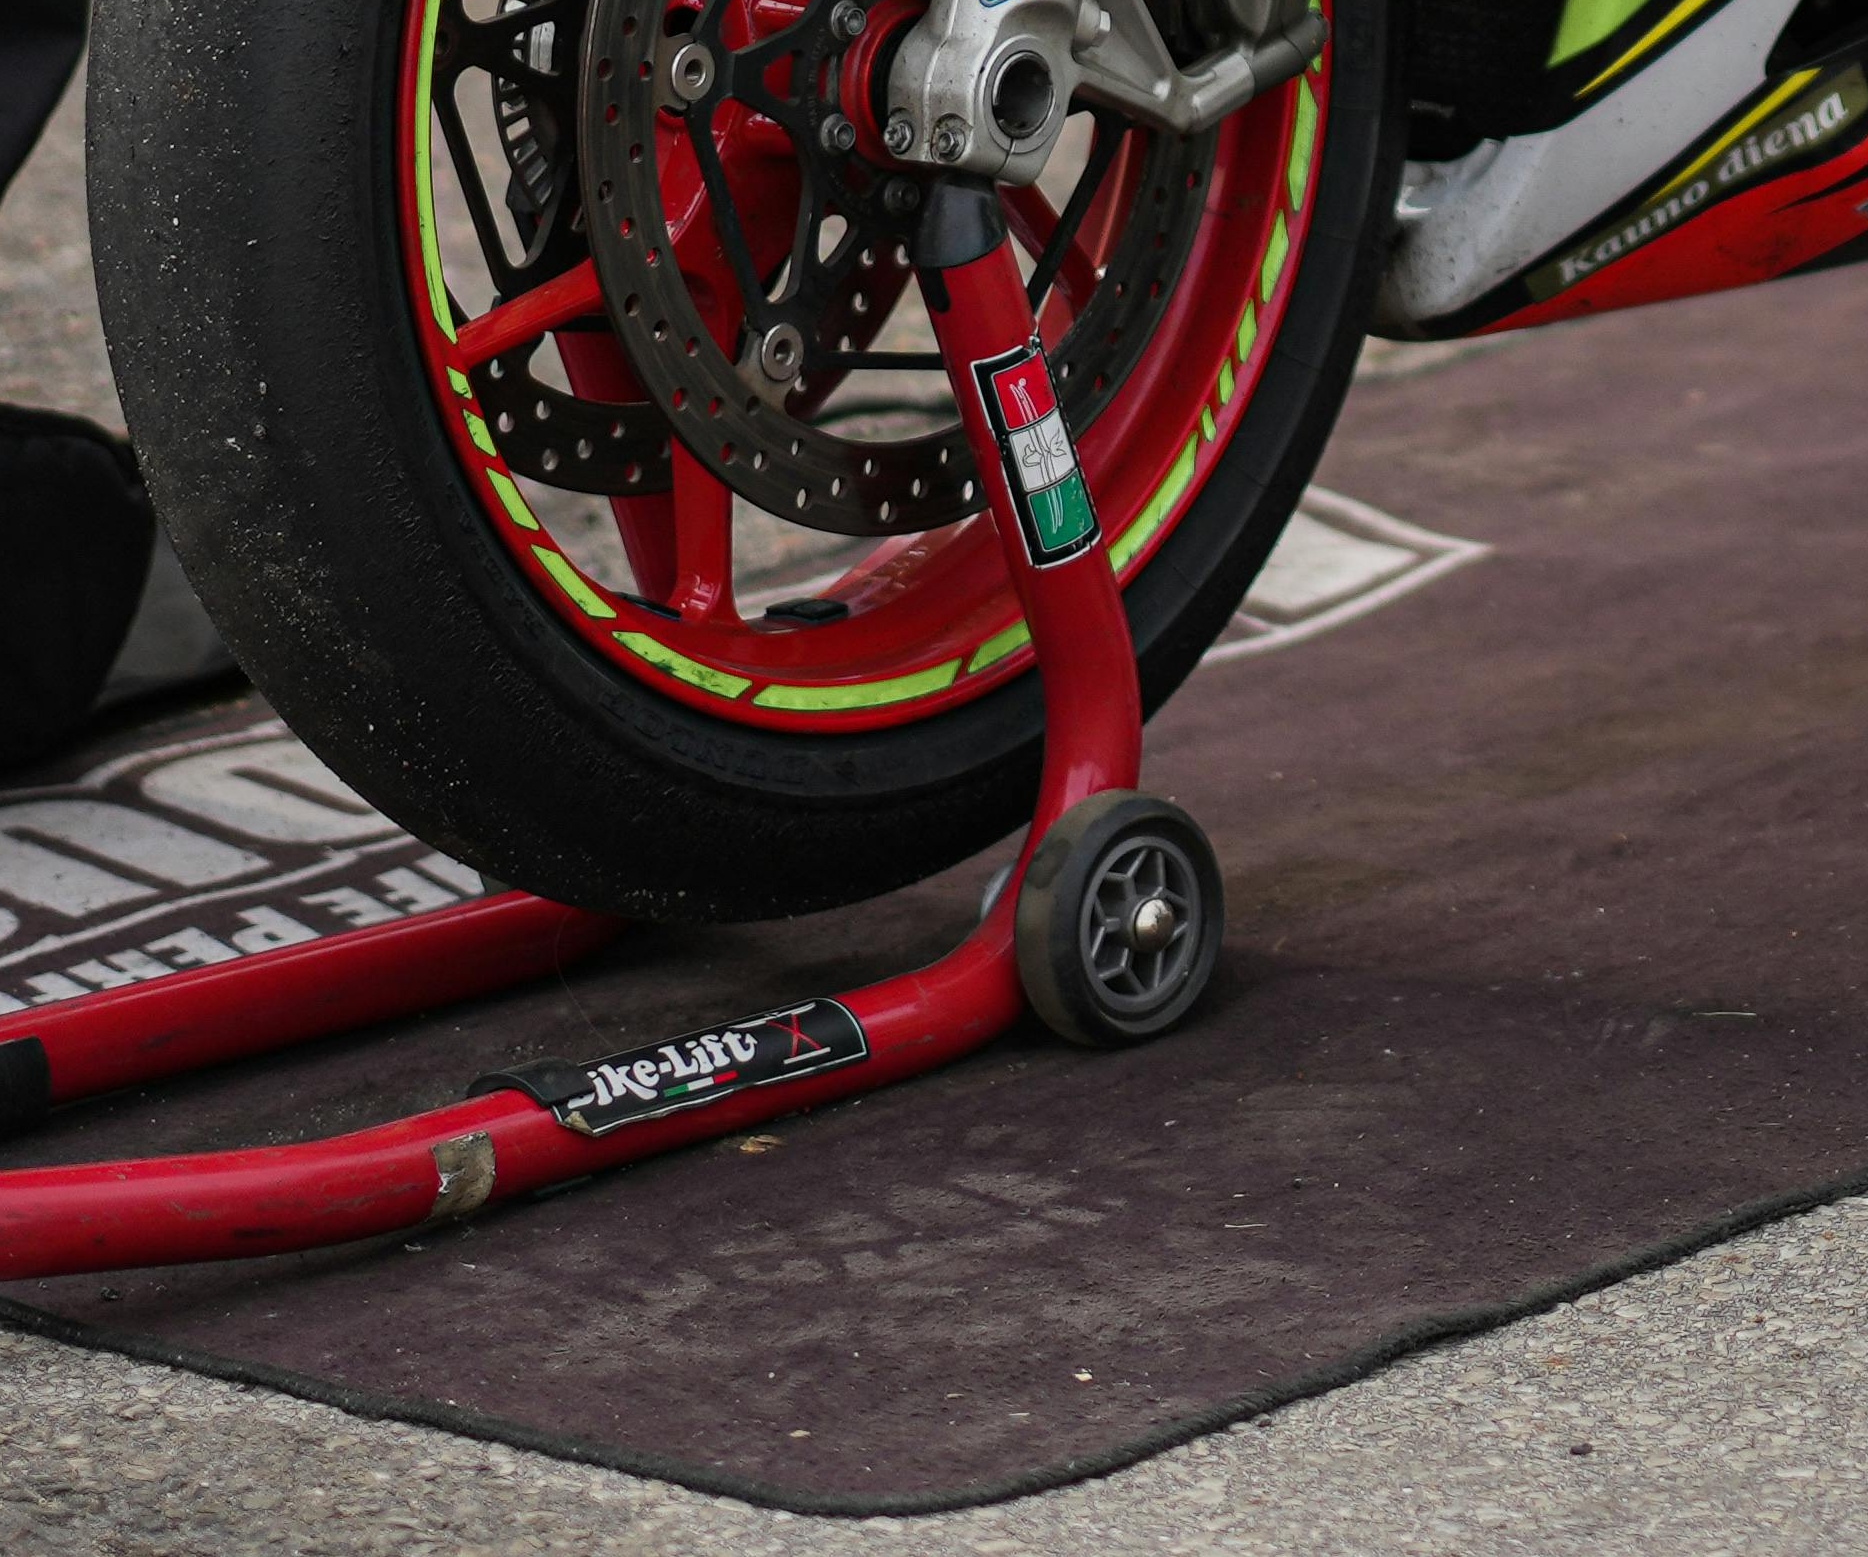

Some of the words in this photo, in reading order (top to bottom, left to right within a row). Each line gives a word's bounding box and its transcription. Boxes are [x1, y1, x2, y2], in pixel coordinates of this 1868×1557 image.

[1558, 179, 1710, 285] Kauno
[1717, 91, 1849, 183] diena
[566, 1025, 761, 1108] ike-Lift
